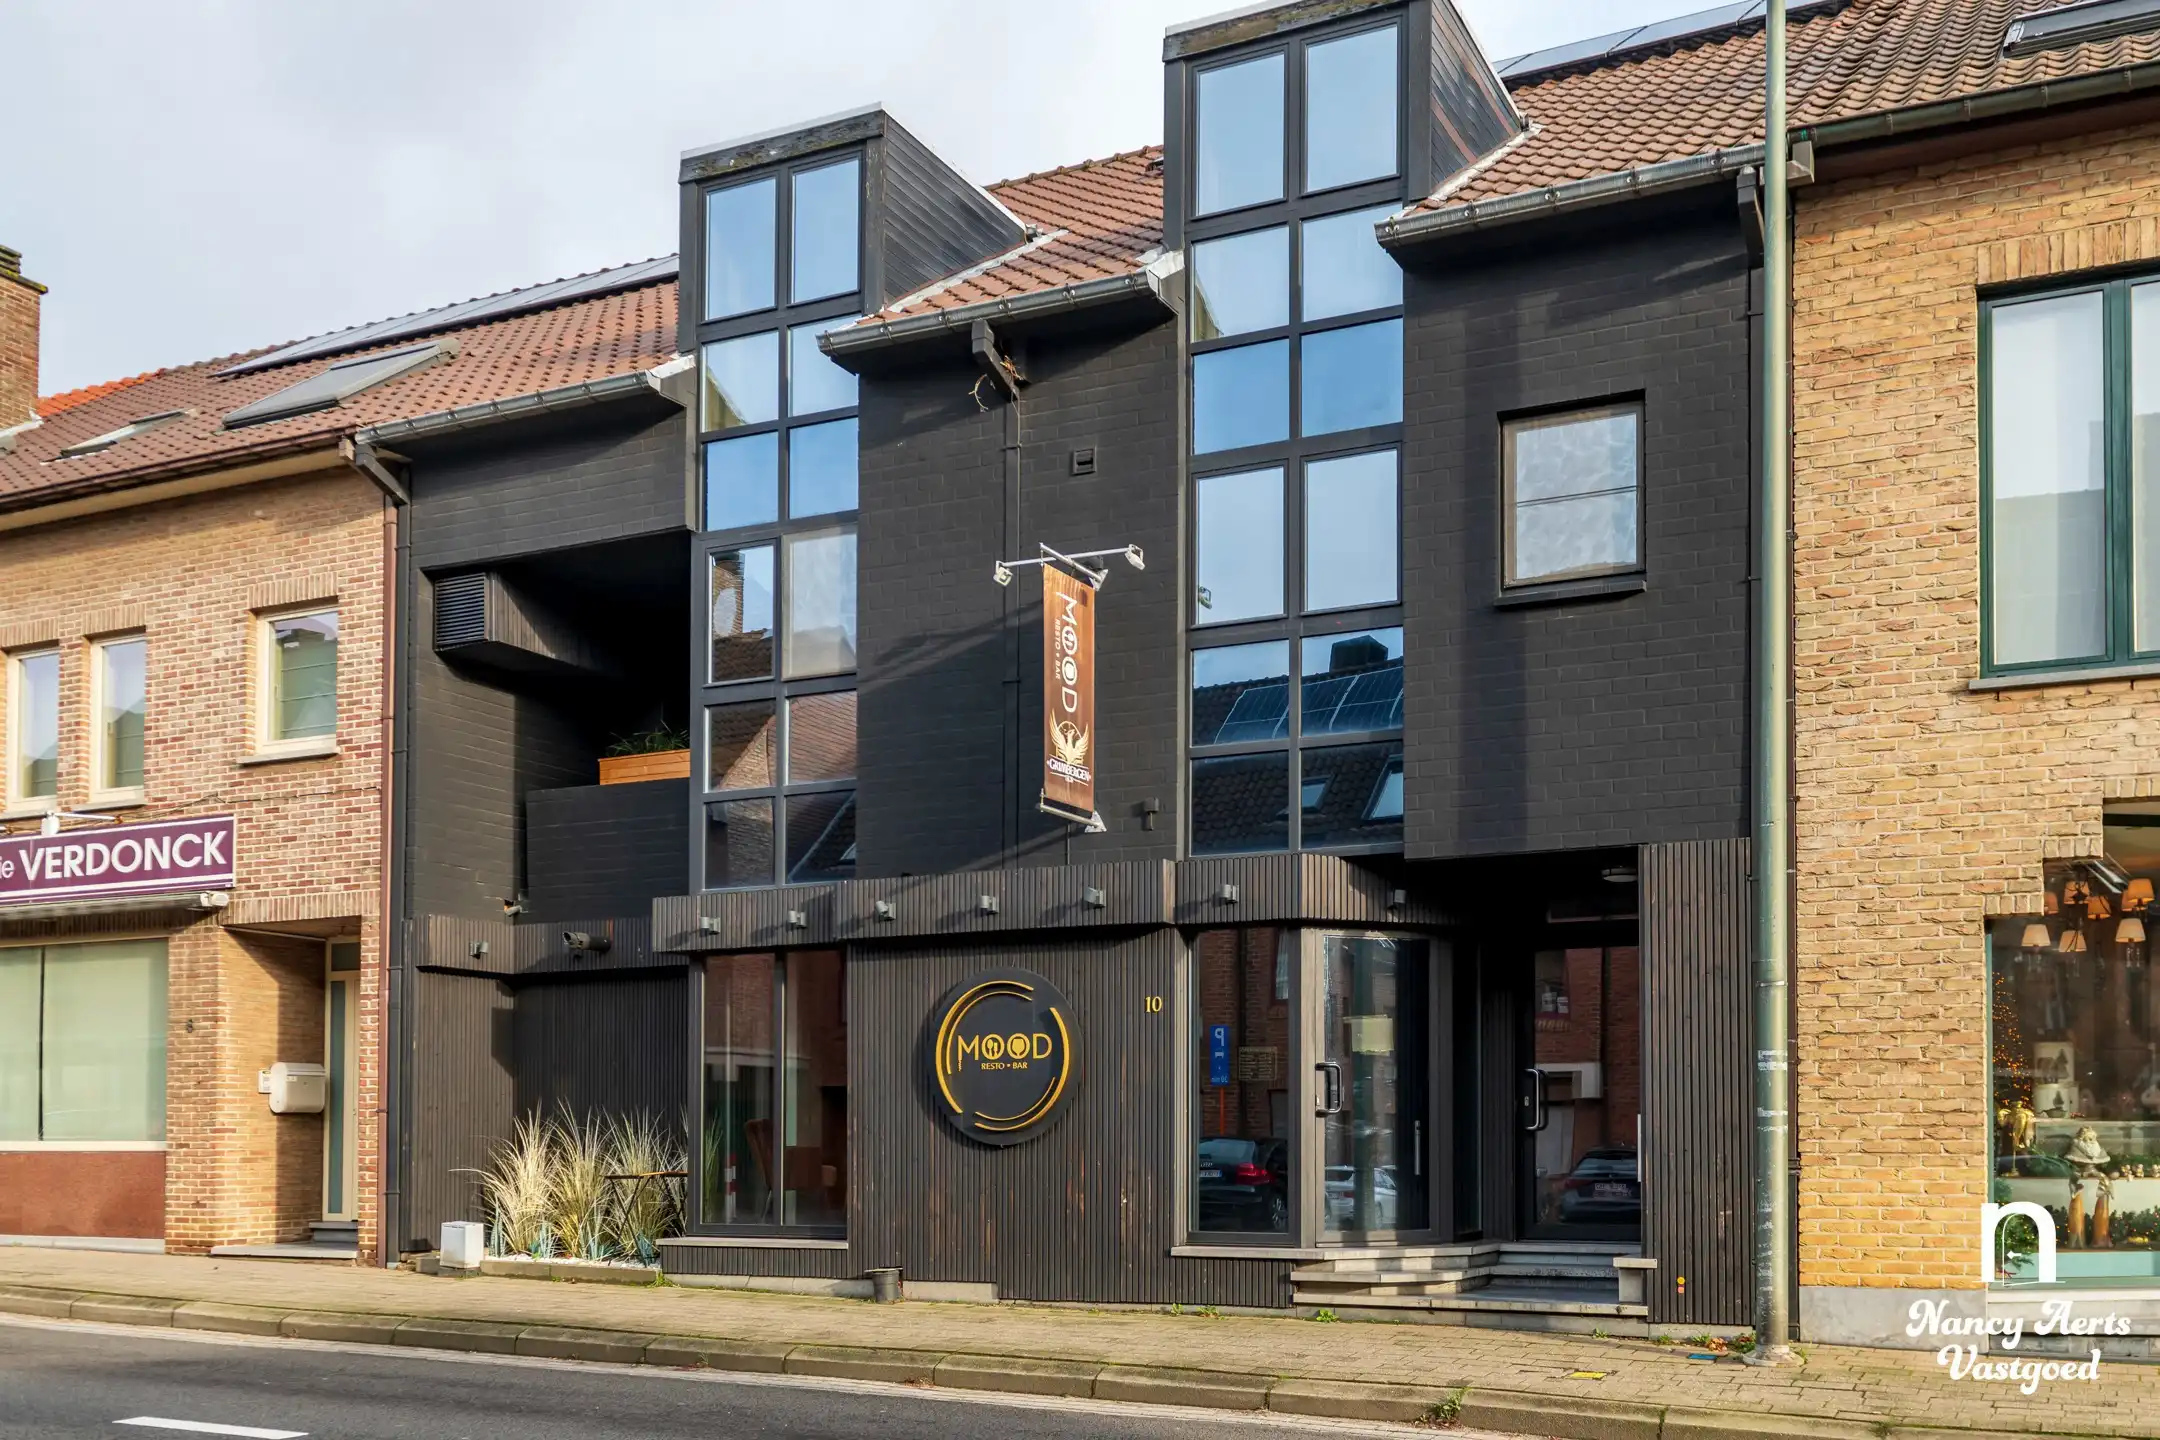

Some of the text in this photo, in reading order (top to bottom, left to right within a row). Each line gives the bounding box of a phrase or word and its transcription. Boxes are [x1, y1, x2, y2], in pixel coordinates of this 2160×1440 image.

[1056, 591, 1078, 713] MOOD
[19, 830, 228, 881] VERDONCK
[1145, 996, 1162, 1013] 10
[957, 1033, 1053, 1071] MOOD
[981, 1061, 1028, 1070] RESTO BAR
